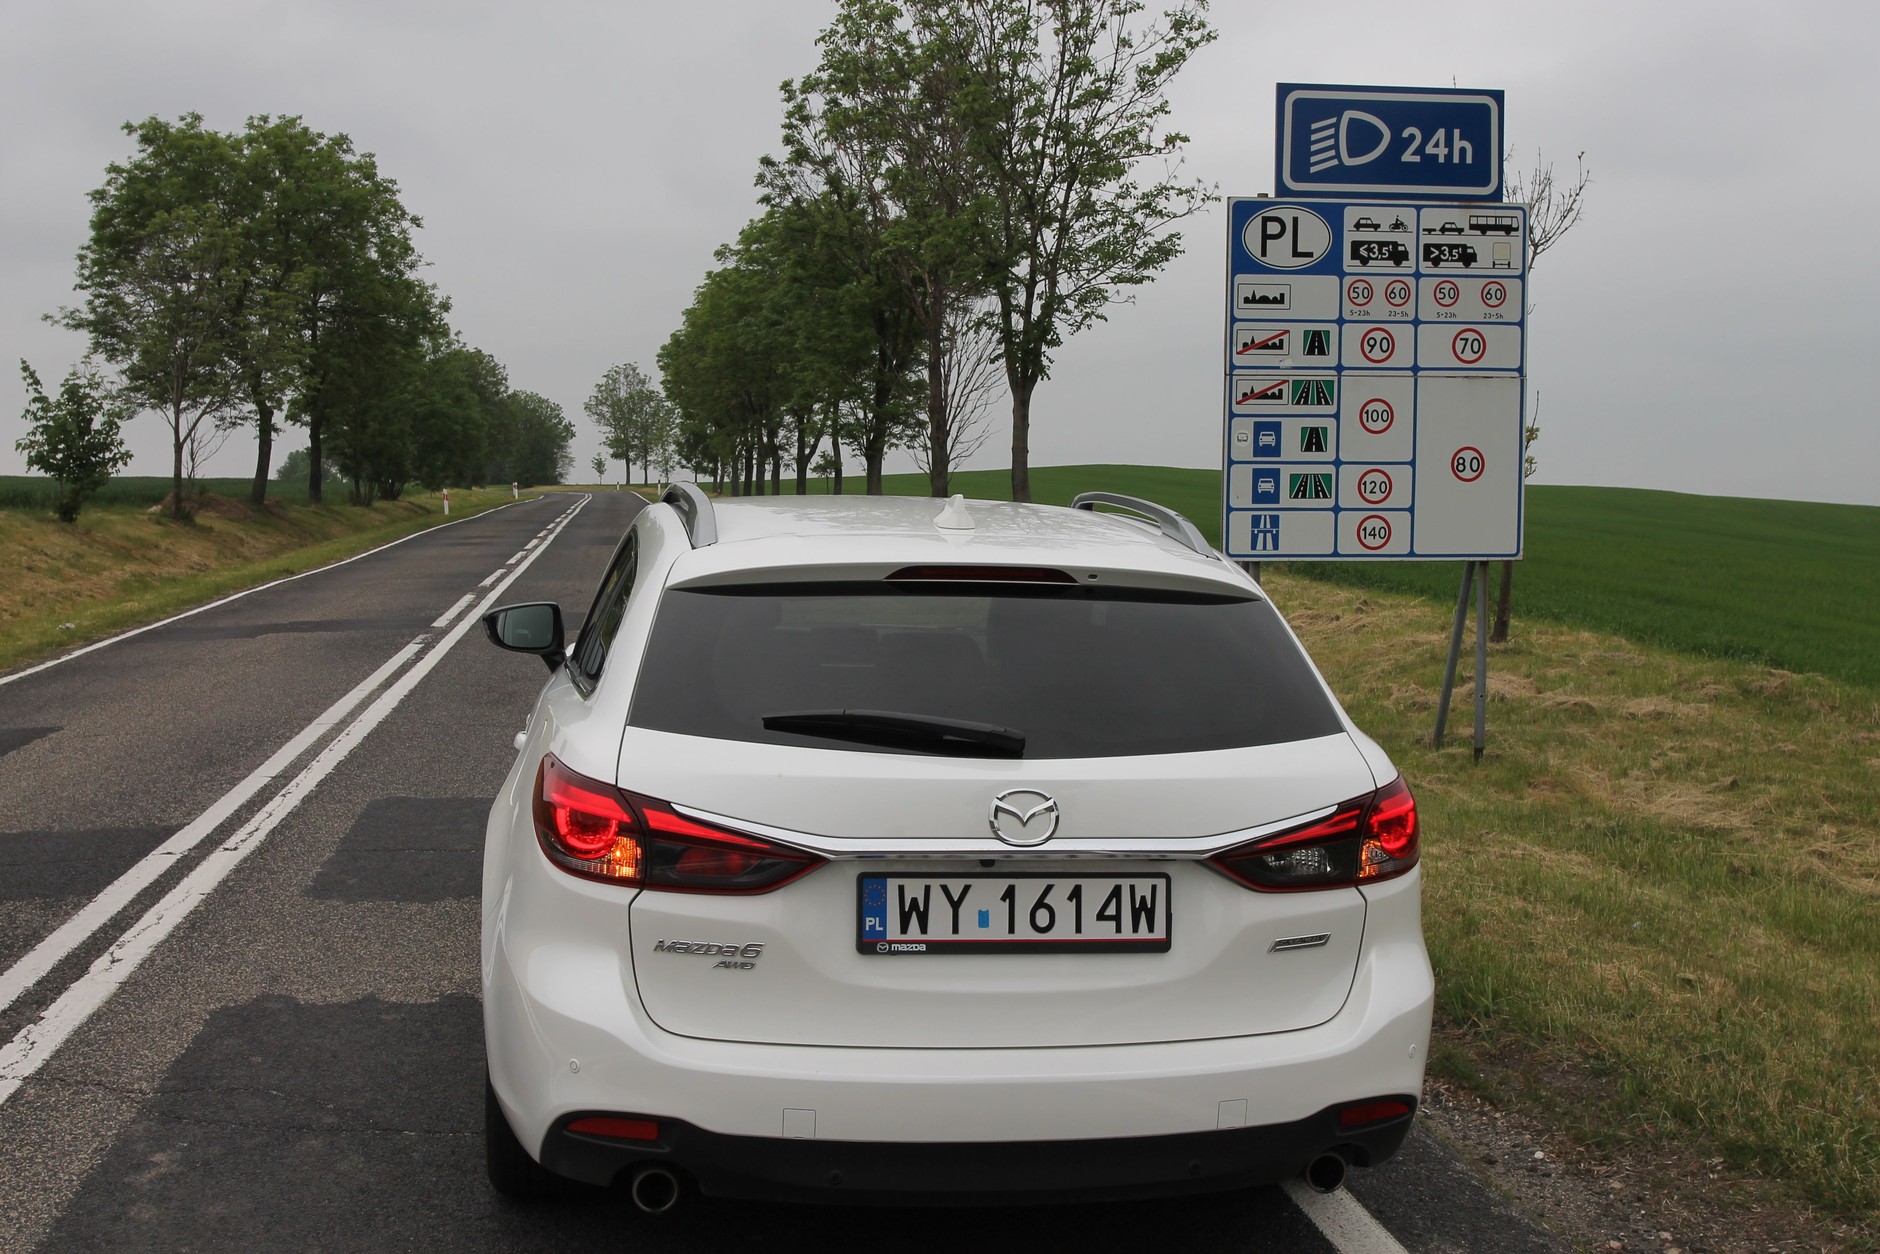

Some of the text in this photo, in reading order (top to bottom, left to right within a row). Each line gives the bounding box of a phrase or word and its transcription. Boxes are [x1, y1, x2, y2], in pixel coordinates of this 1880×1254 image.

[1401, 126, 1473, 164] 24h
[1260, 215, 1314, 258] PL
[1351, 286, 1370, 300] 50
[1388, 286, 1407, 300] 60
[1438, 287, 1456, 300] 50
[1484, 288, 1503, 301] 60
[1349, 309, 1371, 317] 5-23h
[1388, 310, 1409, 318] 23-5h
[1436, 311, 1457, 319] 5-23h
[1483, 312, 1504, 320] 23-5h
[1366, 336, 1391, 354] 90
[1459, 337, 1482, 355] 70
[1364, 408, 1390, 424] 100
[1455, 455, 1481, 474] 80
[1362, 480, 1388, 495] 120
[1361, 526, 1388, 541] 140
[897, 883, 1158, 935] WY 1614W
[865, 917, 884, 931] PL
